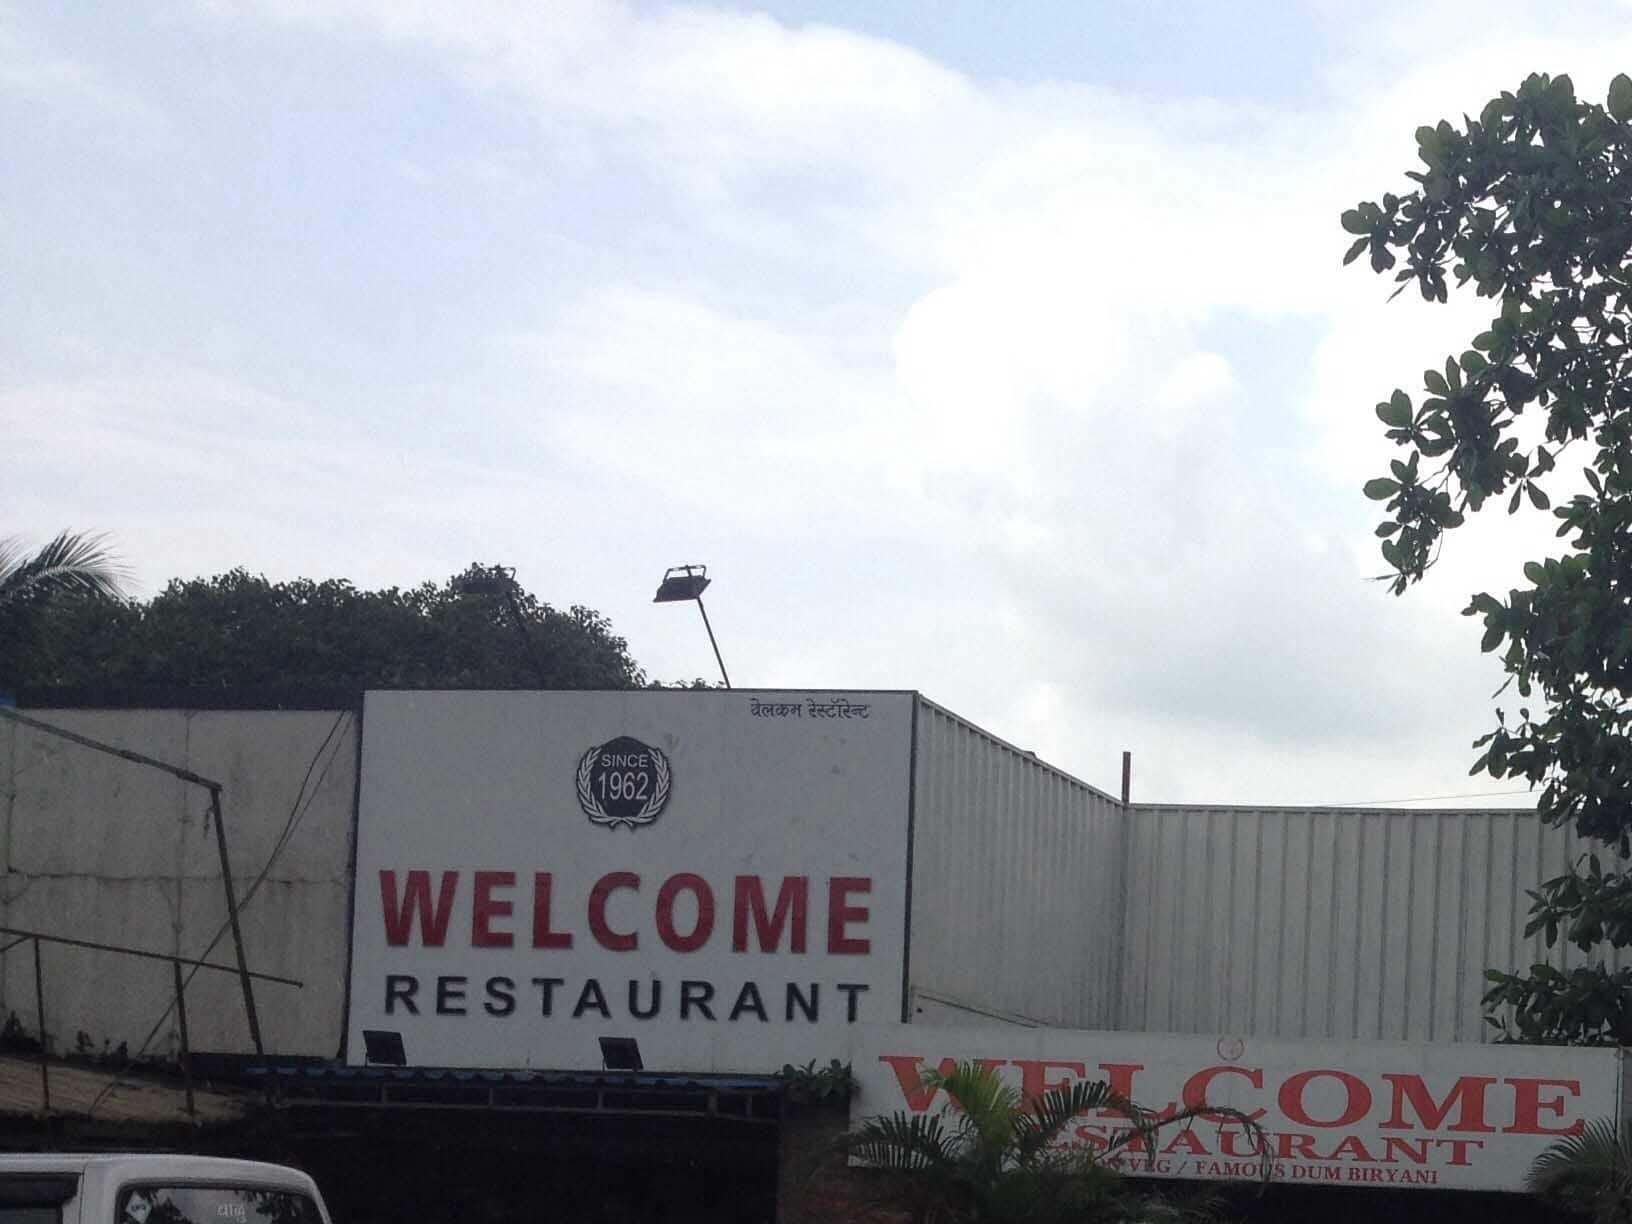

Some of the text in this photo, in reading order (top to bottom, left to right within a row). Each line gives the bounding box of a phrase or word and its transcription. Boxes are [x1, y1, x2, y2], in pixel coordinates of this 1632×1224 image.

[750, 697, 801, 718] वेलकम
[601, 754, 648, 768] SINCE
[599, 771, 648, 800] 1962
[379, 869, 872, 955] WELCOME
[384, 974, 871, 1023] RESTAURANT
[1196, 1160, 1286, 1178] FAMOUS
[1293, 1164, 1342, 1181] DUM
[1349, 1166, 1438, 1185] BIRYANI
